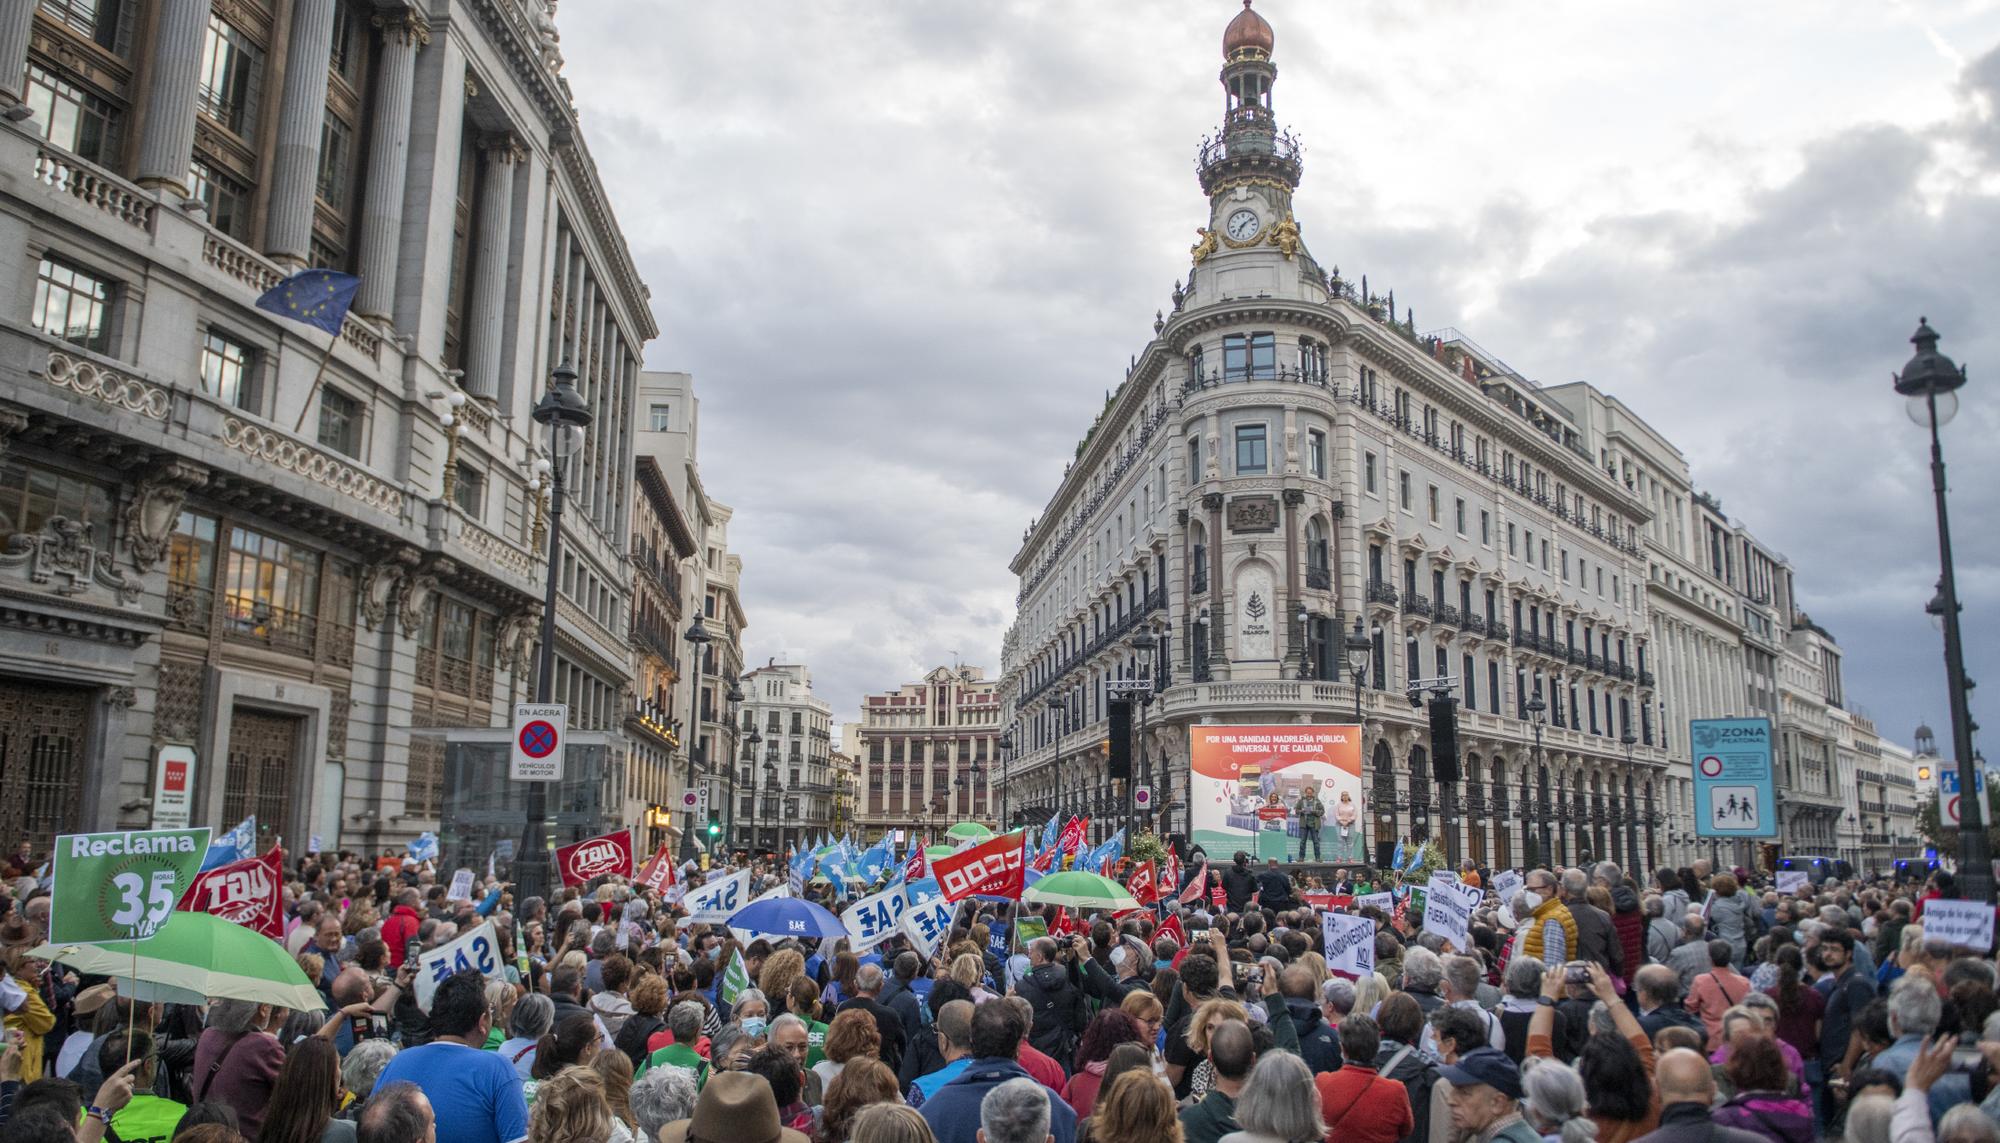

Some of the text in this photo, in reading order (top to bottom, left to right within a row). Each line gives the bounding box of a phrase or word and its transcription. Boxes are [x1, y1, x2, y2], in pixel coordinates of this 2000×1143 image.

[45, 642, 59, 656] 16
[532, 709, 561, 717] ACERA
[1721, 728, 1766, 737] ZONA
[1205, 735, 1220, 743] POR
[1222, 735, 1237, 743] UNA
[1239, 735, 1271, 743] SANIDAD
[1273, 733, 1314, 743] MADRILEÑA
[1232, 744, 1271, 752] UNIVERSAL
[1292, 744, 1323, 752] CALIDAD
[700, 780, 708, 822] HOTEL
[72, 834, 197, 859] Reclama
[153, 871, 175, 881] HORAS
[112, 868, 175, 925] 35
